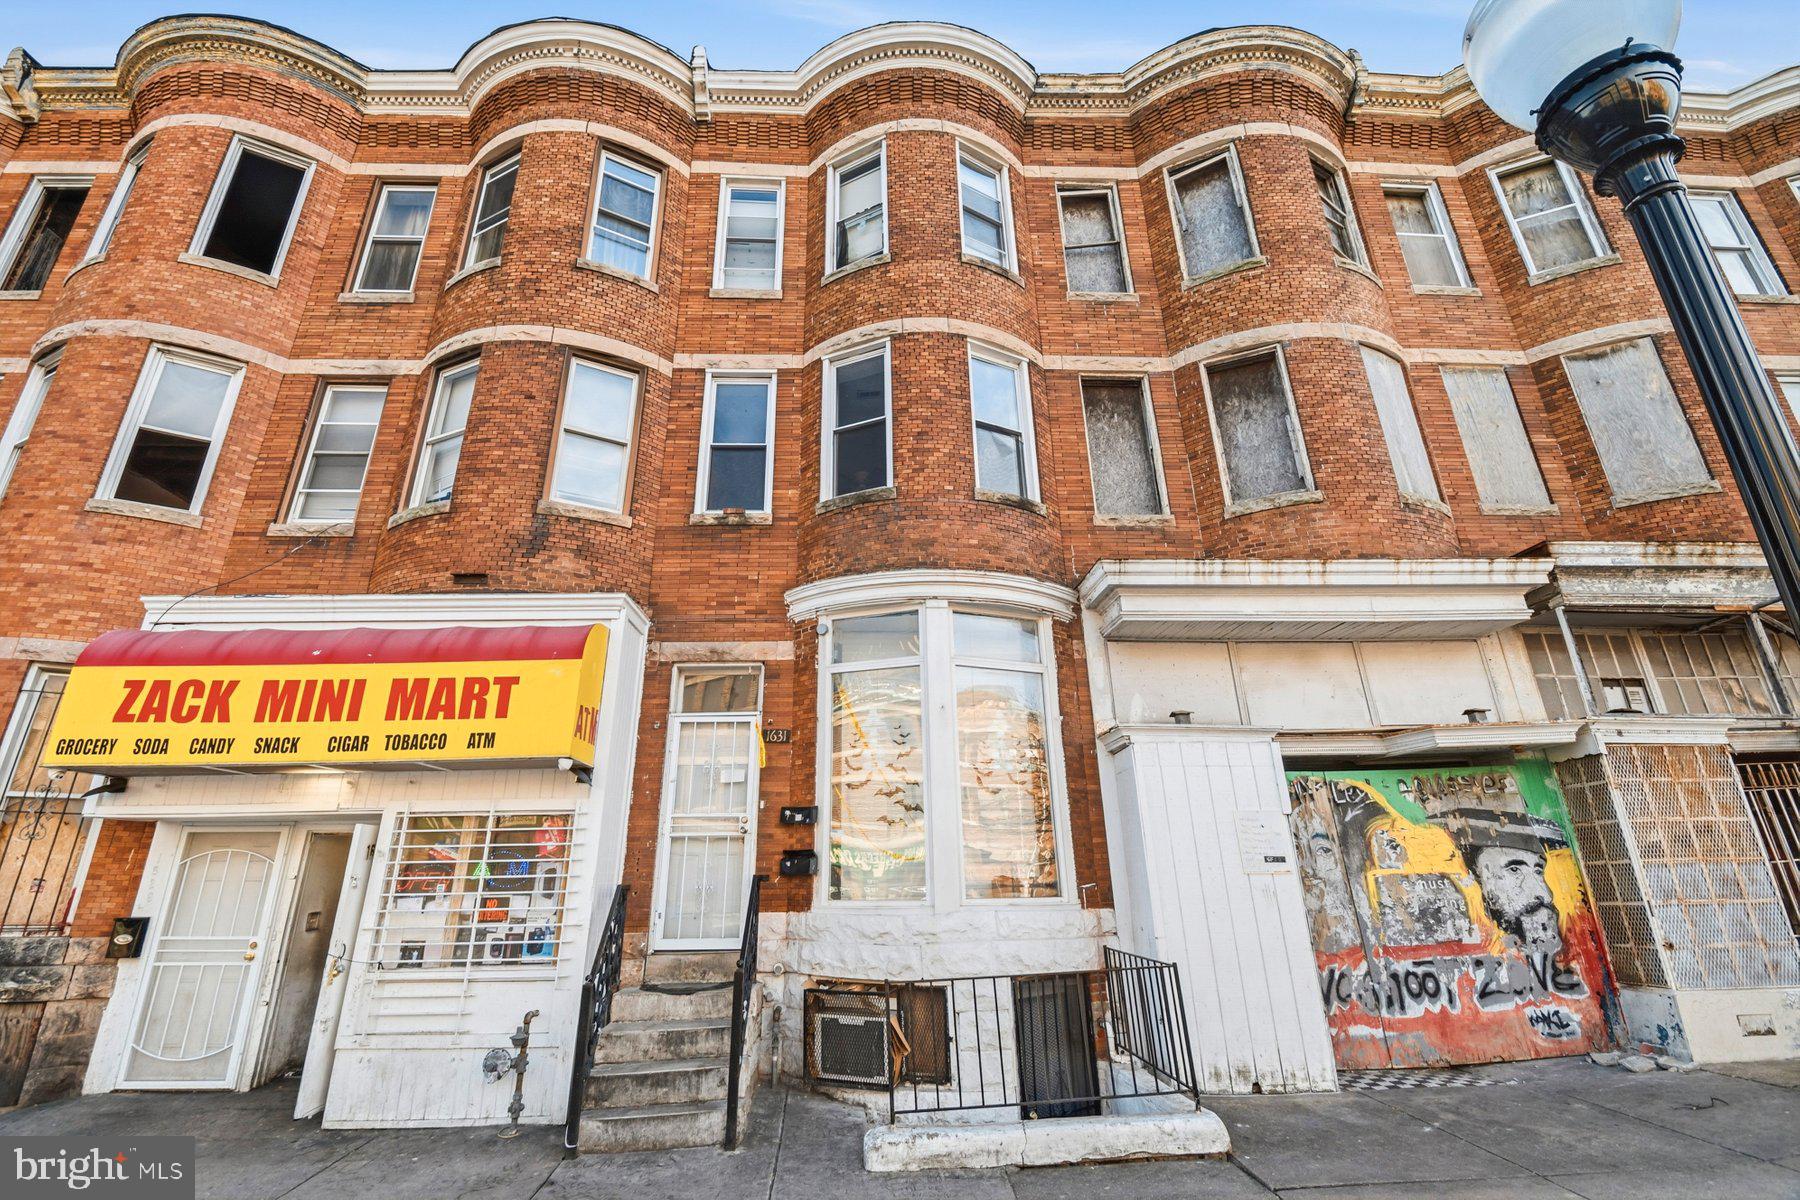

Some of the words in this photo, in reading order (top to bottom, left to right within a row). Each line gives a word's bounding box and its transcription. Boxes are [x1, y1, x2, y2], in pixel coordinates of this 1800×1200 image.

[112, 679, 241, 724] ZACK
[253, 679, 367, 723] MINI
[384, 676, 521, 722] MART
[573, 704, 599, 746] ATM
[56, 738, 119, 755] GROCERY
[133, 738, 170, 755] SODA
[189, 737, 236, 755] CANDY
[254, 736, 301, 754] SNACK
[327, 735, 370, 753] CIGAR
[384, 732, 448, 751] TOBACCO
[466, 731, 497, 750] ATM
[766, 730, 787, 742] 1631
[397, 871, 455, 891] OPEN
[485, 898, 498, 909] NO
[477, 909, 507, 921] ITERING
